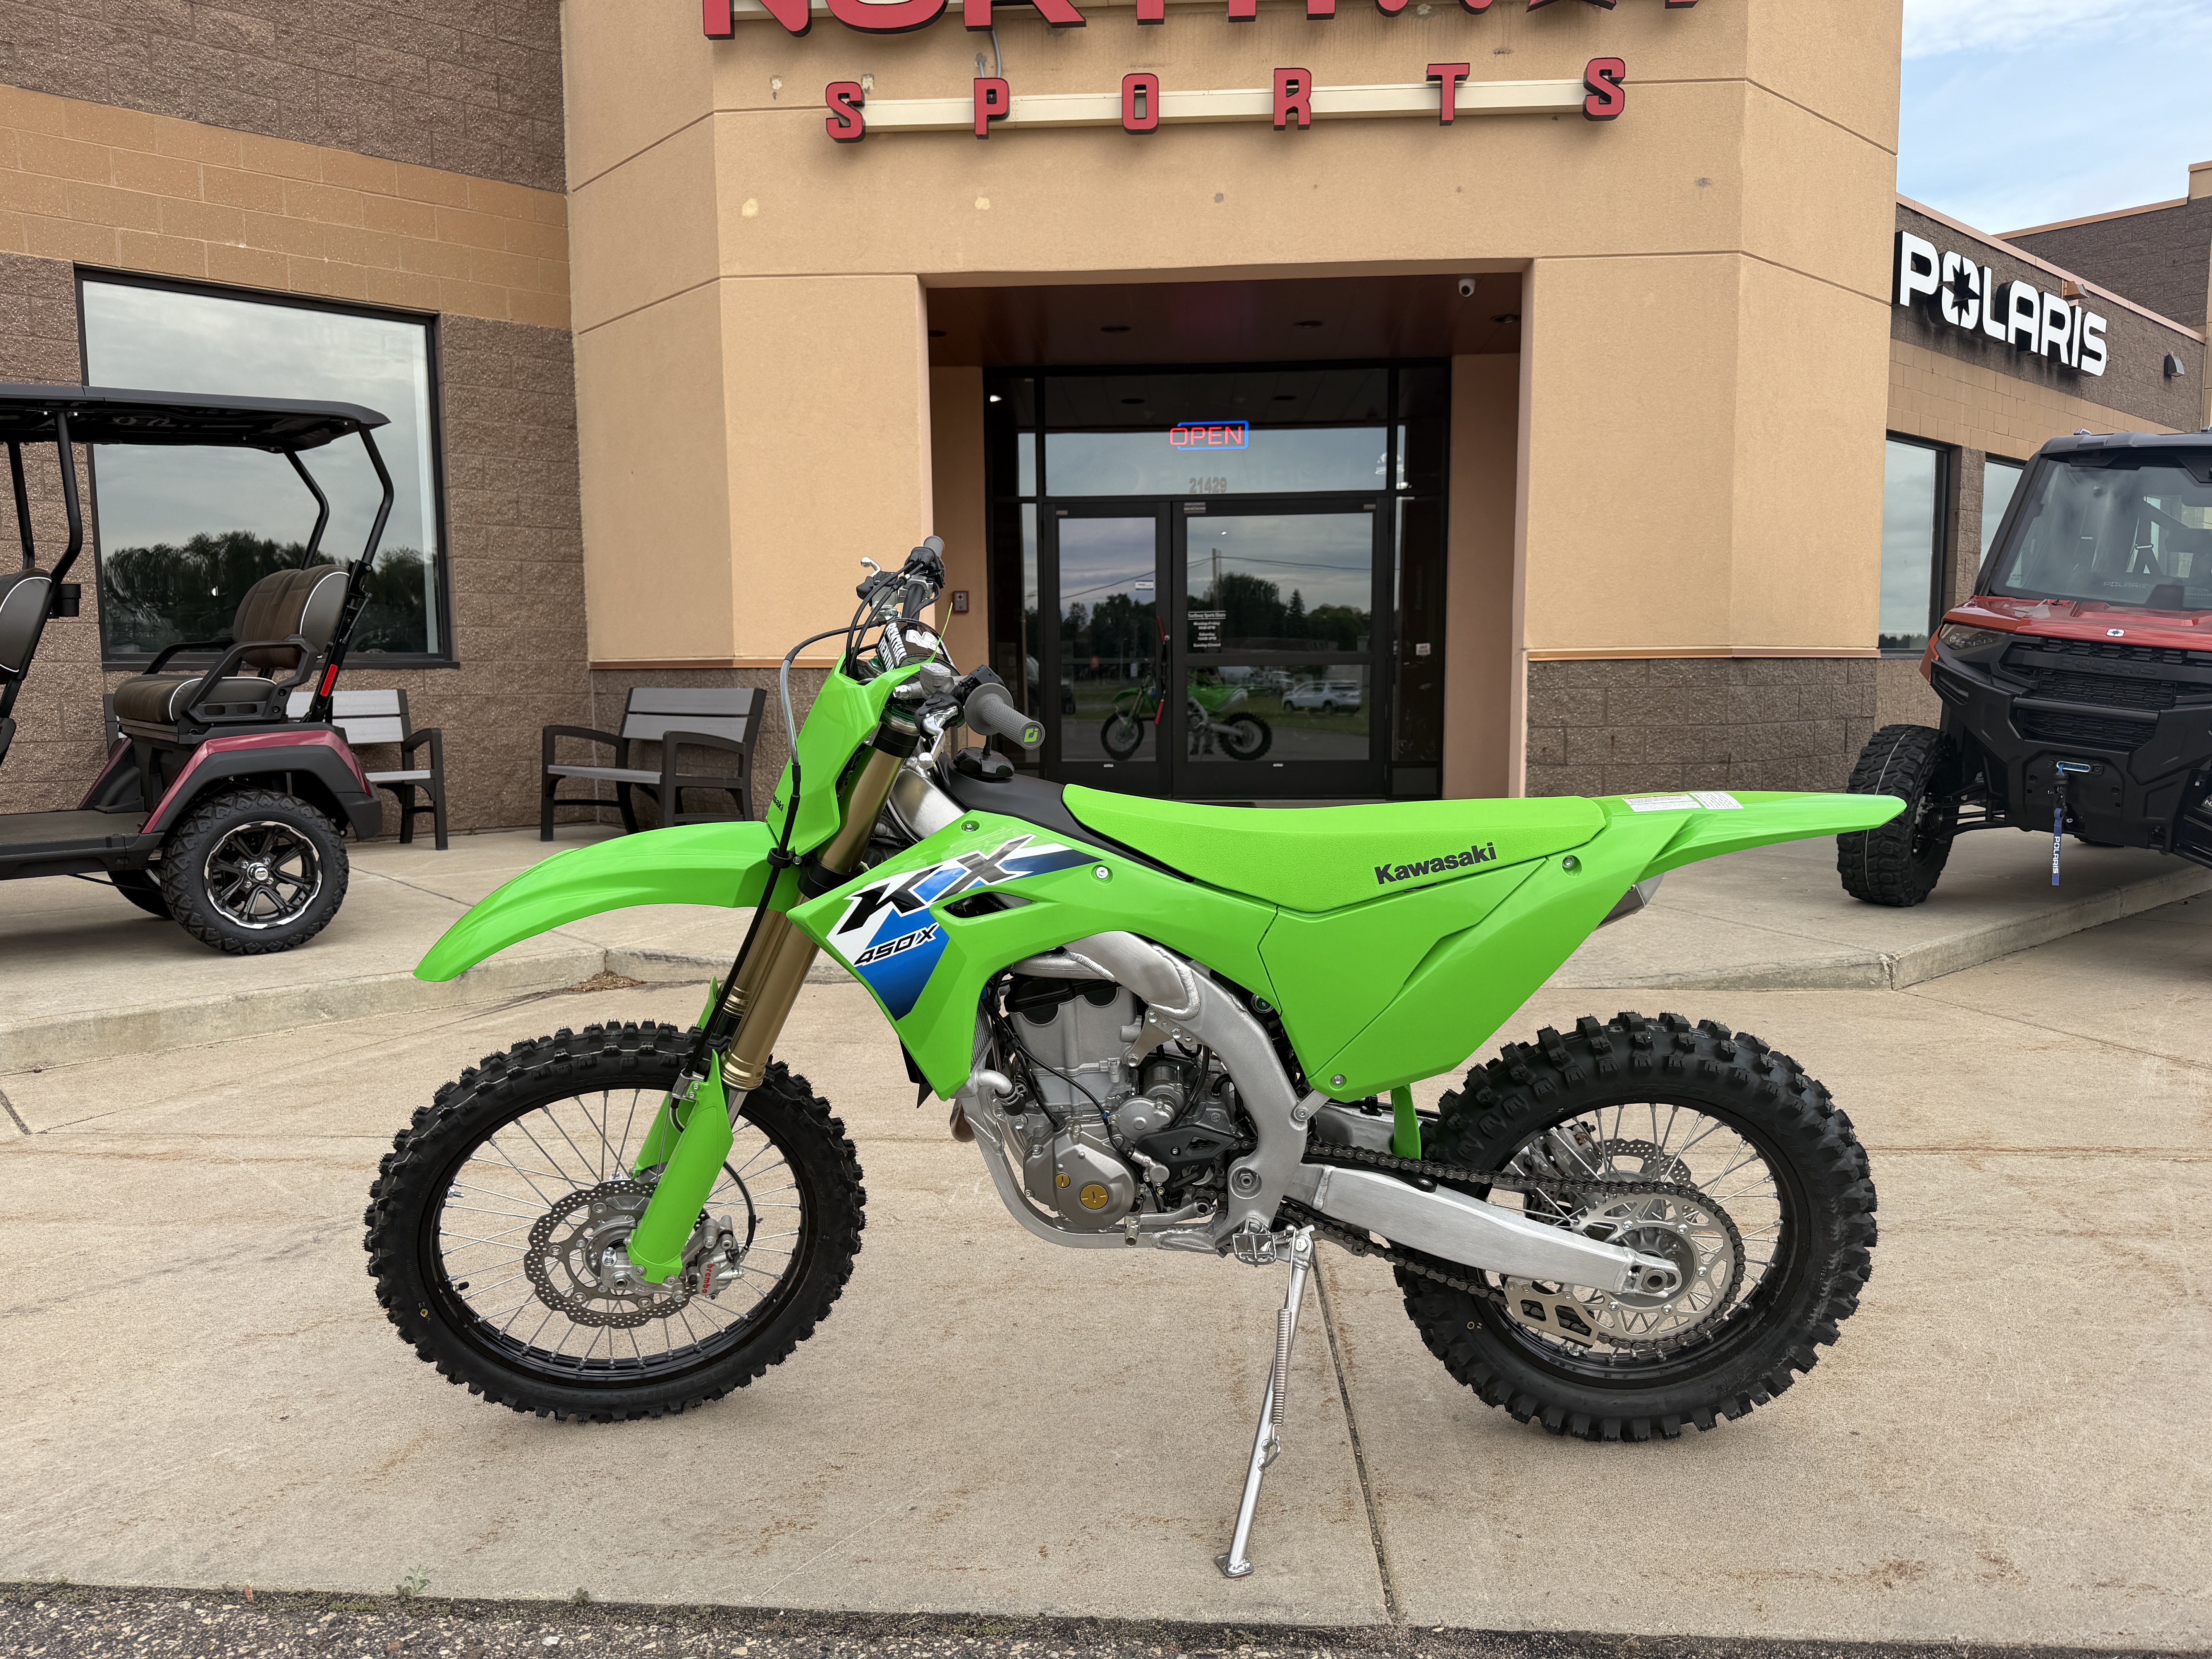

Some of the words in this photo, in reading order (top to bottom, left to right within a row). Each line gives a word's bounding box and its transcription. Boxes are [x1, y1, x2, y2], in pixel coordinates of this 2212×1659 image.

[825, 57, 1625, 142] SPORTS
[1899, 231, 2107, 376] POLARIS
[1170, 426, 1242, 445] OPEN
[1189, 477, 1227, 493] 21429
[885, 622, 907, 667] RENTHAL
[836, 835, 1033, 935] KX
[1374, 842, 1497, 885] Kawasaki
[854, 924, 938, 965] 450X
[702, 1264, 715, 1294] brembo
